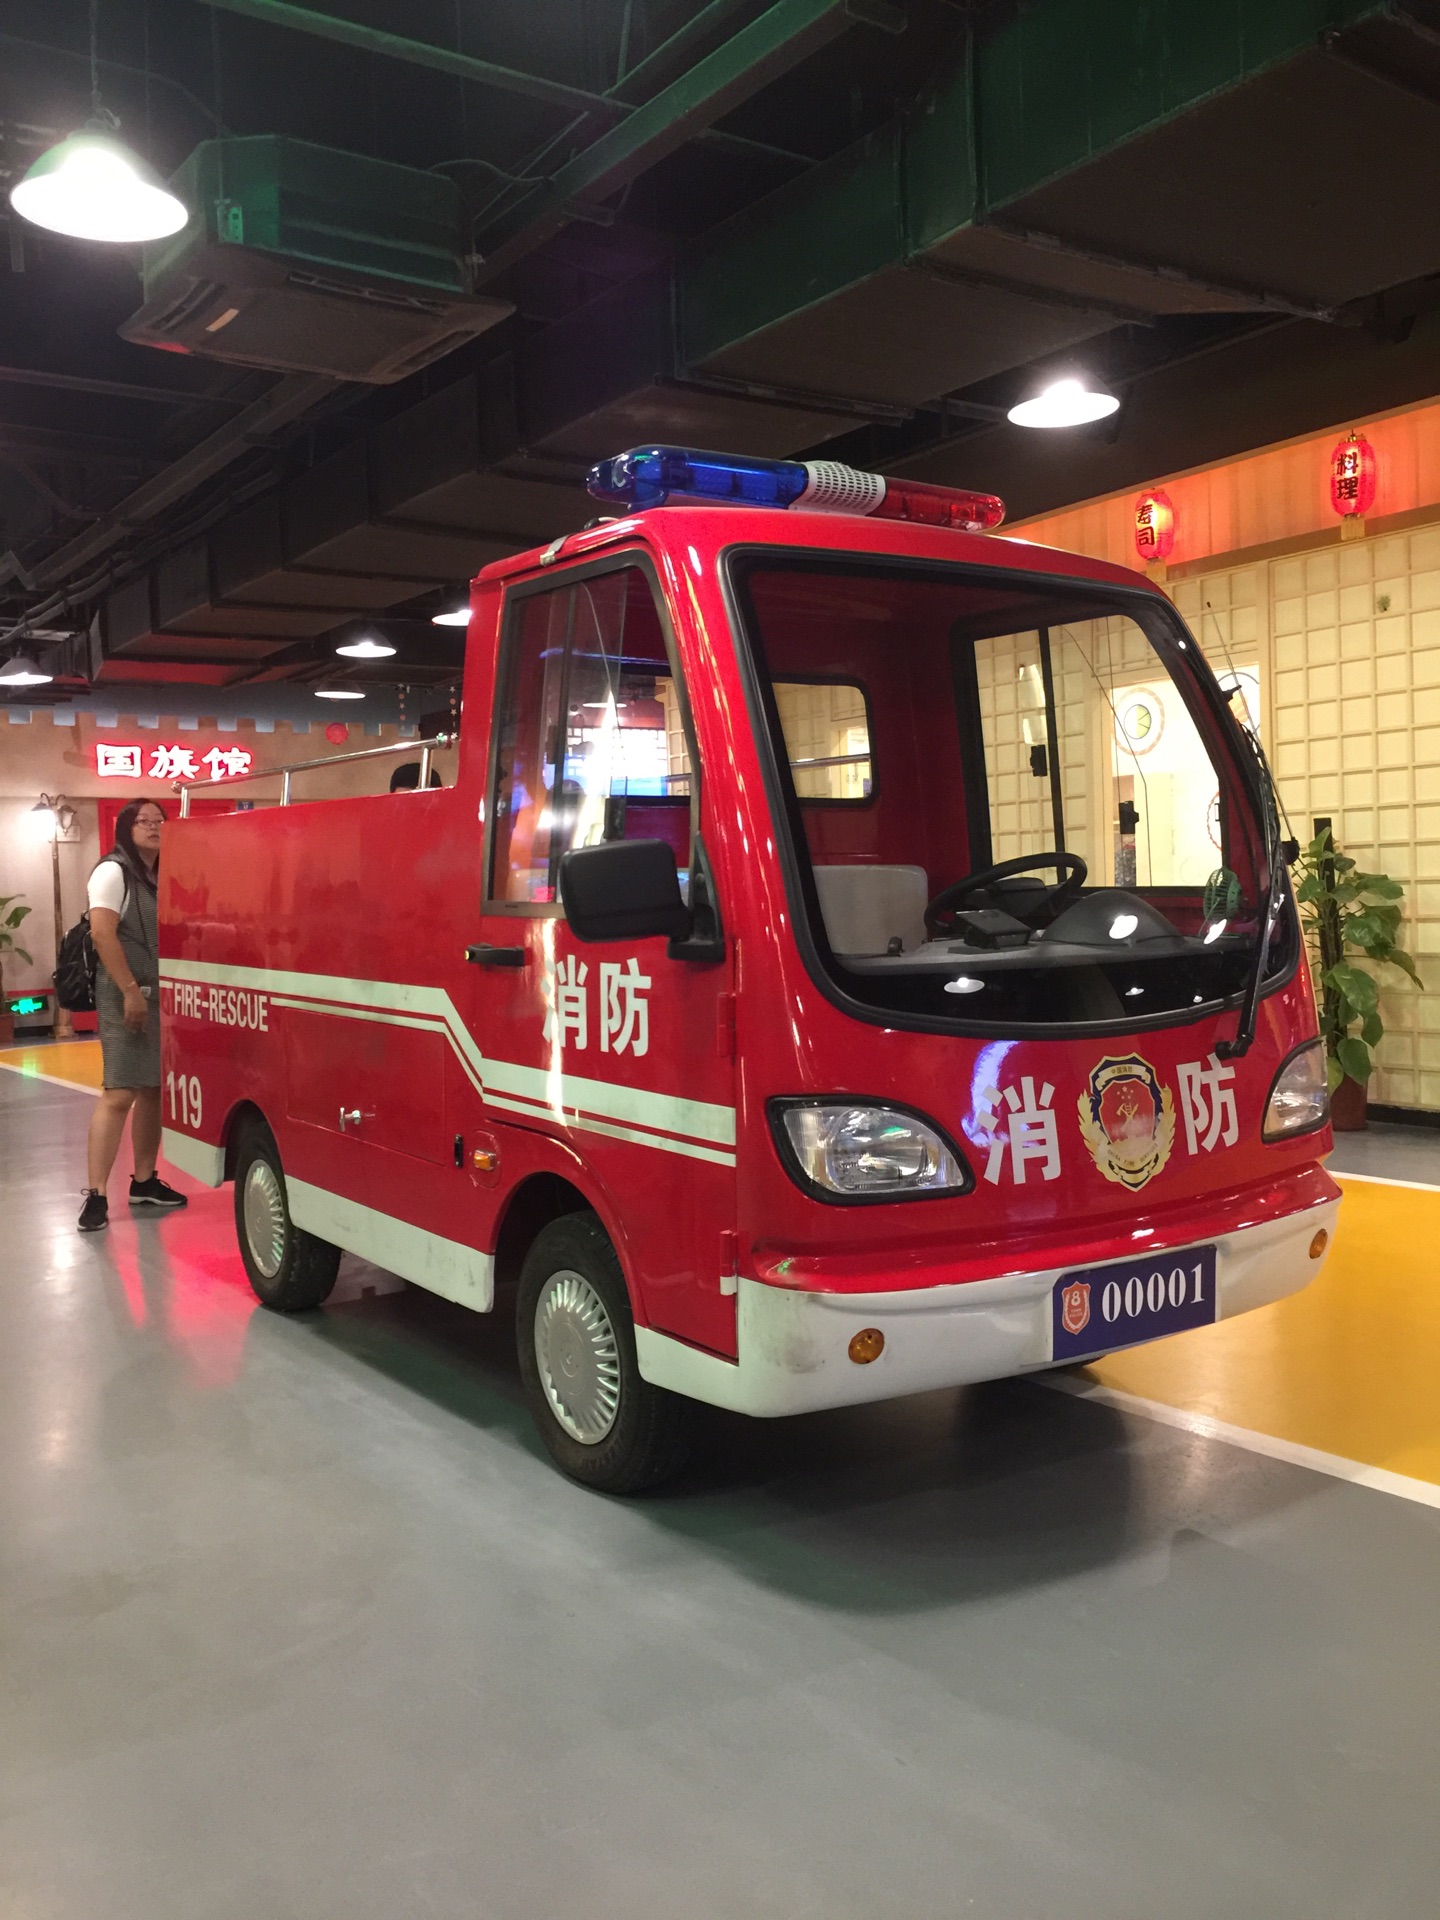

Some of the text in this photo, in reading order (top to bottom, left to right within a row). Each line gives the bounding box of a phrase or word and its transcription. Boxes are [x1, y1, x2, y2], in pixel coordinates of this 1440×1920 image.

[1337, 452, 1358, 499] 料理
[1137, 504, 1155, 545] 寿司
[96, 743, 252, 781] 国旗馆
[174, 982, 269, 1033] FIRE-RESCUE
[541, 953, 652, 1057] 消防
[166, 1070, 203, 1129] 119
[975, 1051, 1239, 1185] 消 防
[1071, 1290, 1081, 1306] 8
[1102, 1263, 1205, 1322] 00001
